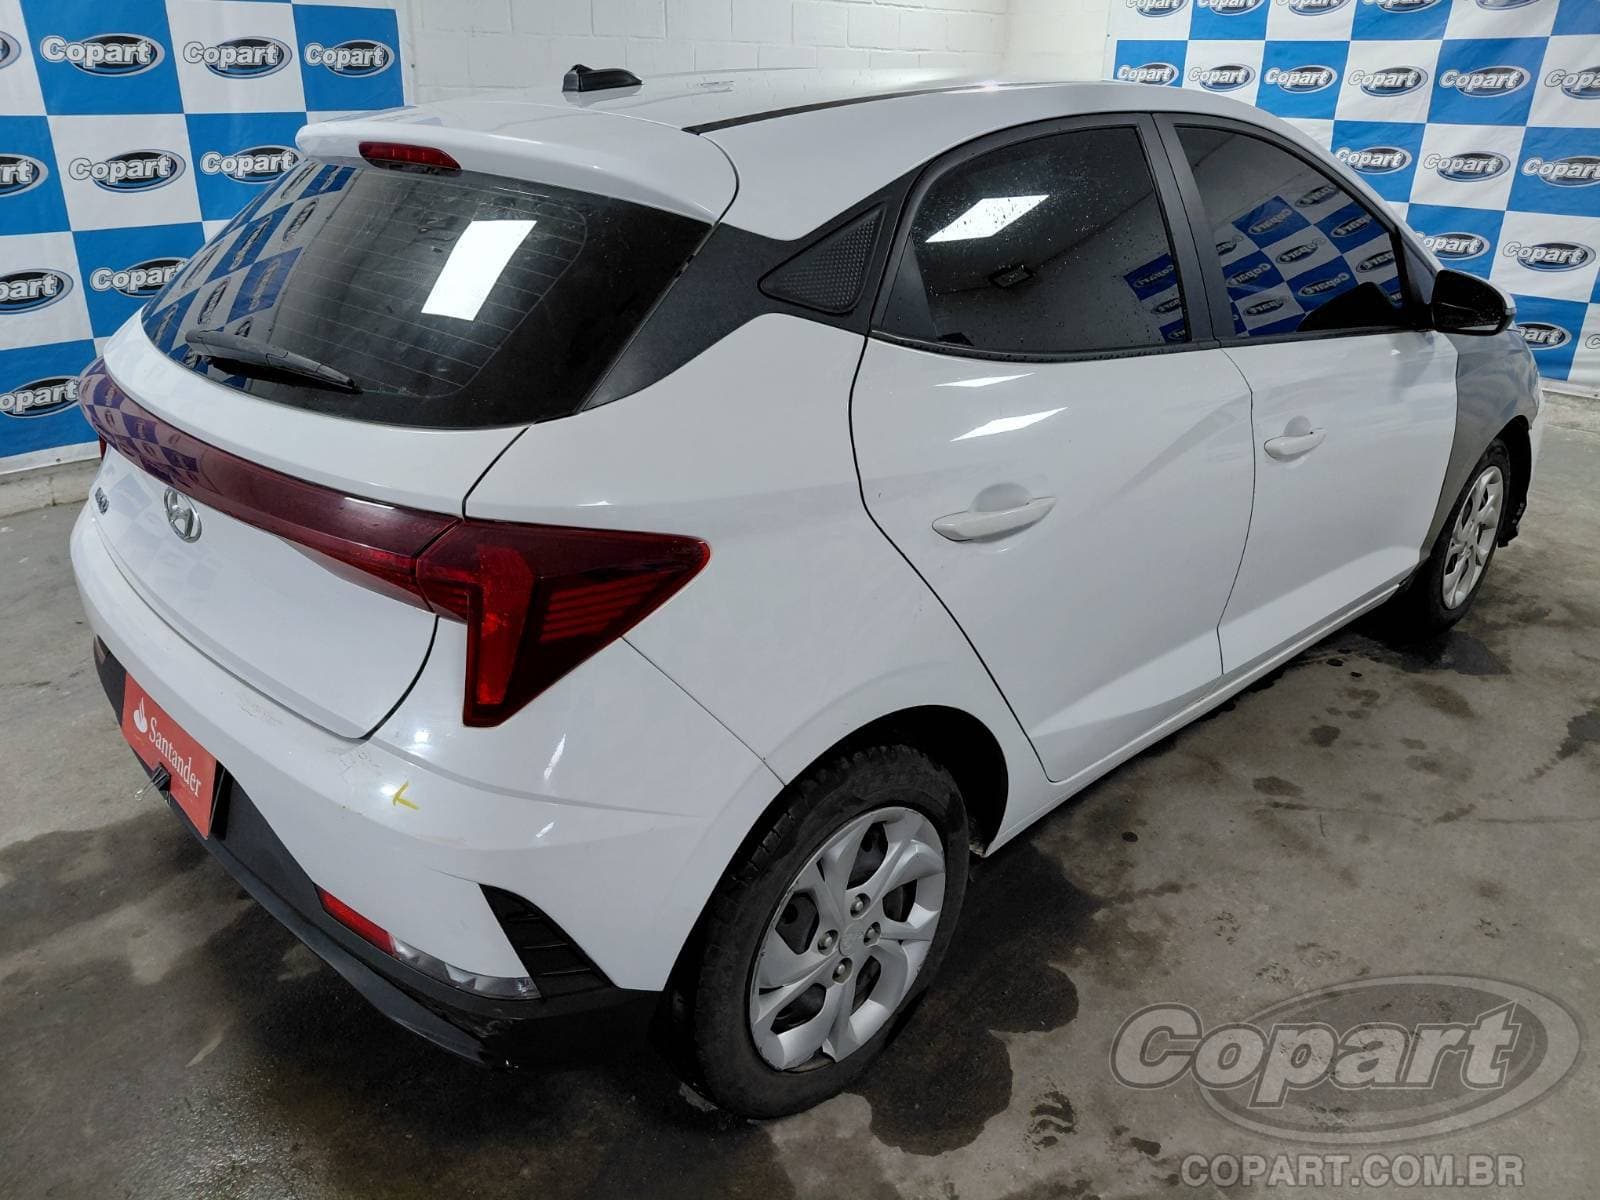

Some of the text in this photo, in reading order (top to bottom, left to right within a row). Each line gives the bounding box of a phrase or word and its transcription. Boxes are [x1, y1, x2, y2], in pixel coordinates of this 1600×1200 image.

[41, 36, 152, 68] Copart
[184, 41, 278, 70] Copart
[305, 43, 385, 71] Copart
[1117, 65, 1172, 84] Copart
[1188, 67, 1245, 86] Copart
[1264, 67, 1330, 87] Copart
[1348, 69, 1418, 90] Copart
[1440, 69, 1520, 91] Copart
[1544, 69, 1600, 92] Cop
[69, 152, 170, 183] Copart
[201, 149, 293, 178] Copart
[1335, 147, 1403, 168] Copart
[1423, 153, 1503, 175] Copart
[1503, 241, 1587, 265] Copart
[0, 379, 80, 414] opart
[149, 716, 202, 798] Santander
